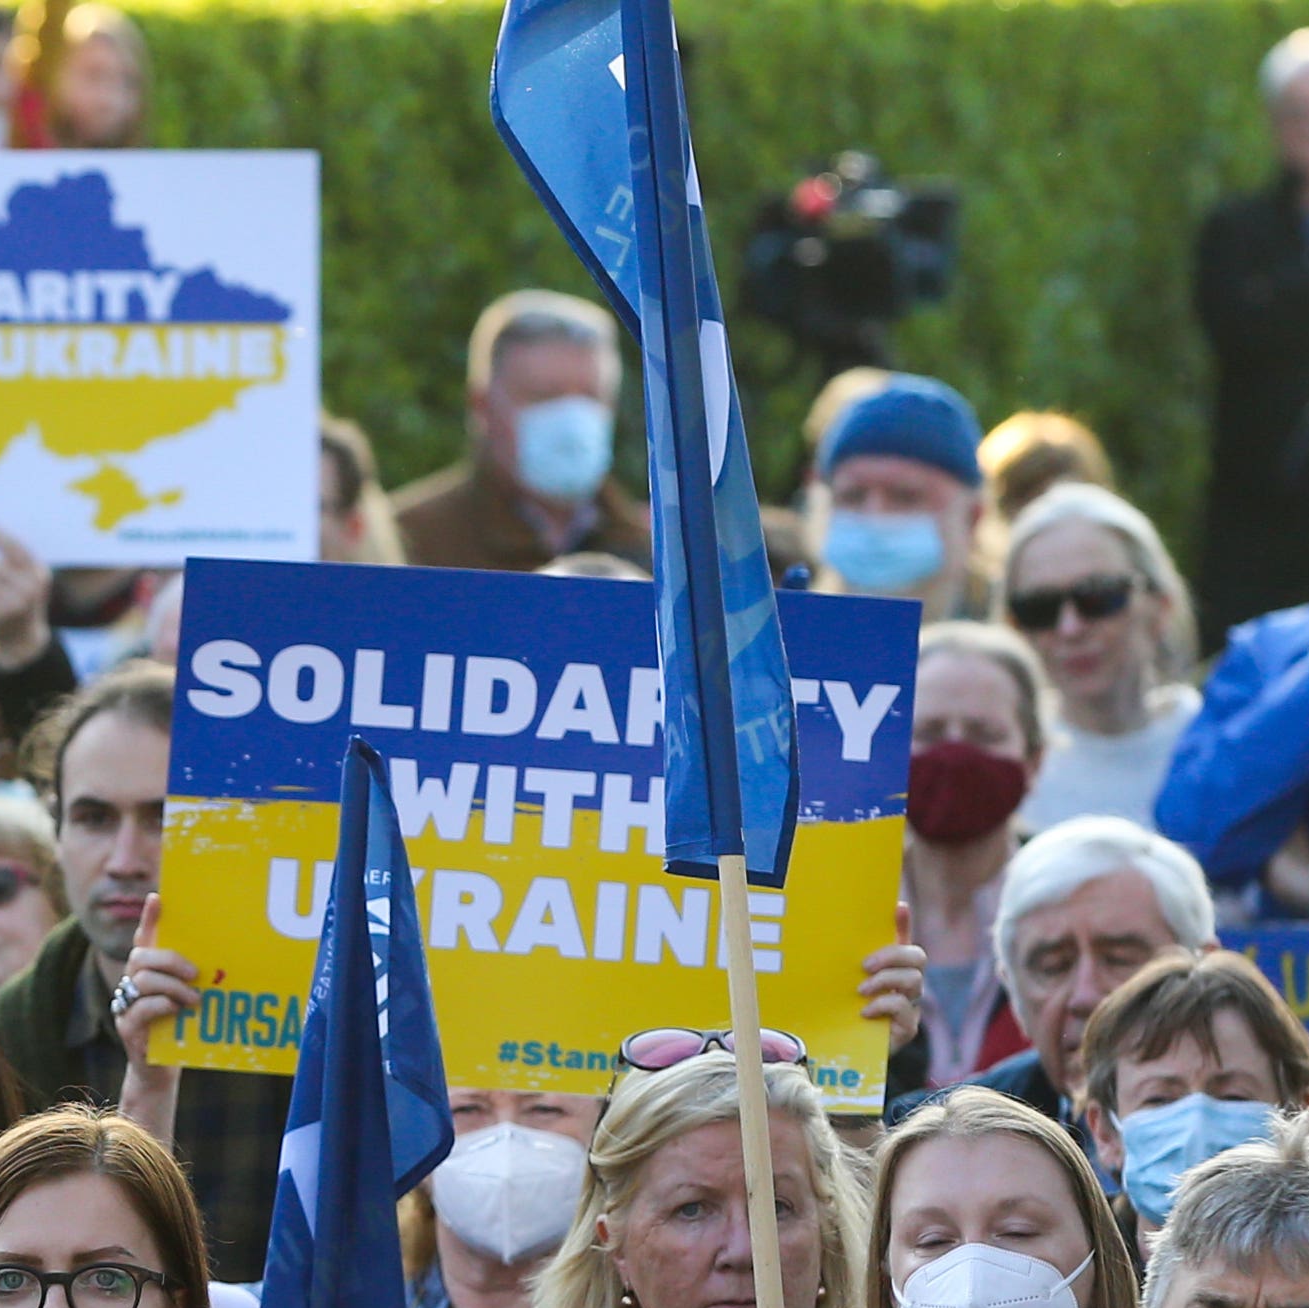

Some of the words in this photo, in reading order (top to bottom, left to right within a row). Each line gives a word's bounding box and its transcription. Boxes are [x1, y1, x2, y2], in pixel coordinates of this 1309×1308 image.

[188, 640, 900, 762] SOLIDARY
[389, 757, 667, 859] WITH
[266, 856, 787, 974] URAINE
